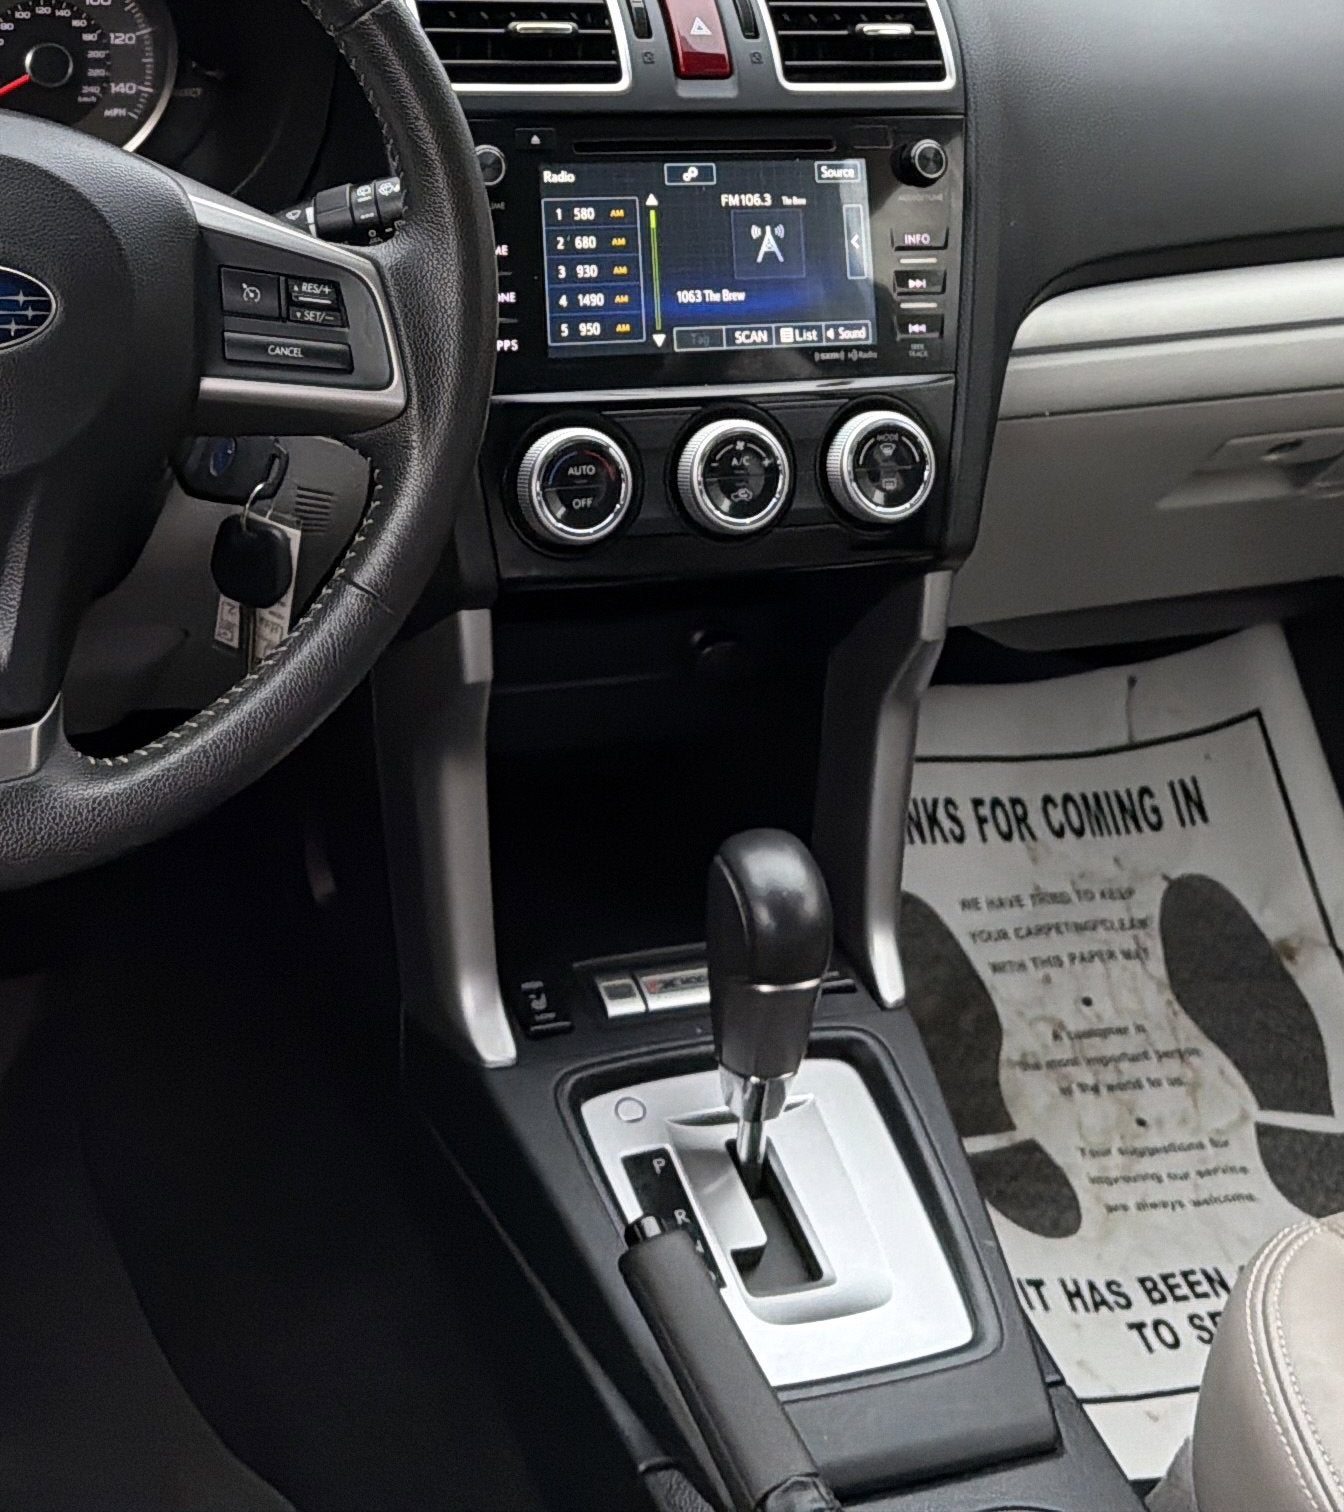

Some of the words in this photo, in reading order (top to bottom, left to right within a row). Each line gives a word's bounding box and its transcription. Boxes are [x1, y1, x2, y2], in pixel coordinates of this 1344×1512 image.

[15, 11, 31, 19] 100
[35, 6, 52, 14] 120
[55, 9, 71, 17] 140
[0, 22, 14, 31] 80
[72, 19, 87, 27] 160
[109, 32, 136, 45] 120
[110, 82, 136, 94] 140
[104, 108, 127, 117] MPH
[543, 170, 576, 183] Radio
[820, 166, 855, 179] Source
[556, 208, 562, 220] 1
[573, 207, 595, 220] 580
[610, 209, 625, 218] AM
[556, 237, 565, 249] 2
[574, 236, 597, 249] 680
[611, 237, 626, 246] AM
[904, 233, 931, 245] INFO
[558, 265, 566, 278] 3
[576, 265, 598, 278] 930
[613, 266, 628, 275] AM
[558, 295, 568, 307] 4
[578, 293, 605, 307] 1490
[614, 296, 629, 304] AM
[676, 290, 702, 303] 1063
[703, 290, 720, 302] The
[722, 289, 746, 302] Brew
[561, 324, 569, 337] 5
[579, 322, 601, 336] 950
[616, 324, 631, 333] AM
[795, 328, 818, 341] List
[838, 327, 866, 339] Sound
[734, 331, 768, 344] SCAN
[268, 345, 304, 357] CANCEL
[496, 339, 519, 351] PPS
[731, 456, 750, 467] A/C
[567, 465, 596, 476] AUTO
[572, 498, 593, 509] OFF
[907, 797, 966, 844] NKS
[971, 796, 1038, 843] FOR
[1041, 785, 1163, 838] COMING
[1167, 775, 1209, 828] IN
[985, 895, 1024, 911] HAVE
[1075, 888, 1096, 902] TO
[969, 928, 1009, 943] YOUR
[989, 959, 1027, 974] WITH
[1031, 955, 1064, 969] THIS
[1068, 949, 1117, 966] PAPER
[653, 1157, 666, 1174] P
[674, 1208, 690, 1225] R
[1016, 1277, 1050, 1312] IT
[1058, 1277, 1133, 1313] HAS
[1137, 1266, 1232, 1306] BEEN
[1126, 1318, 1181, 1355] TO
